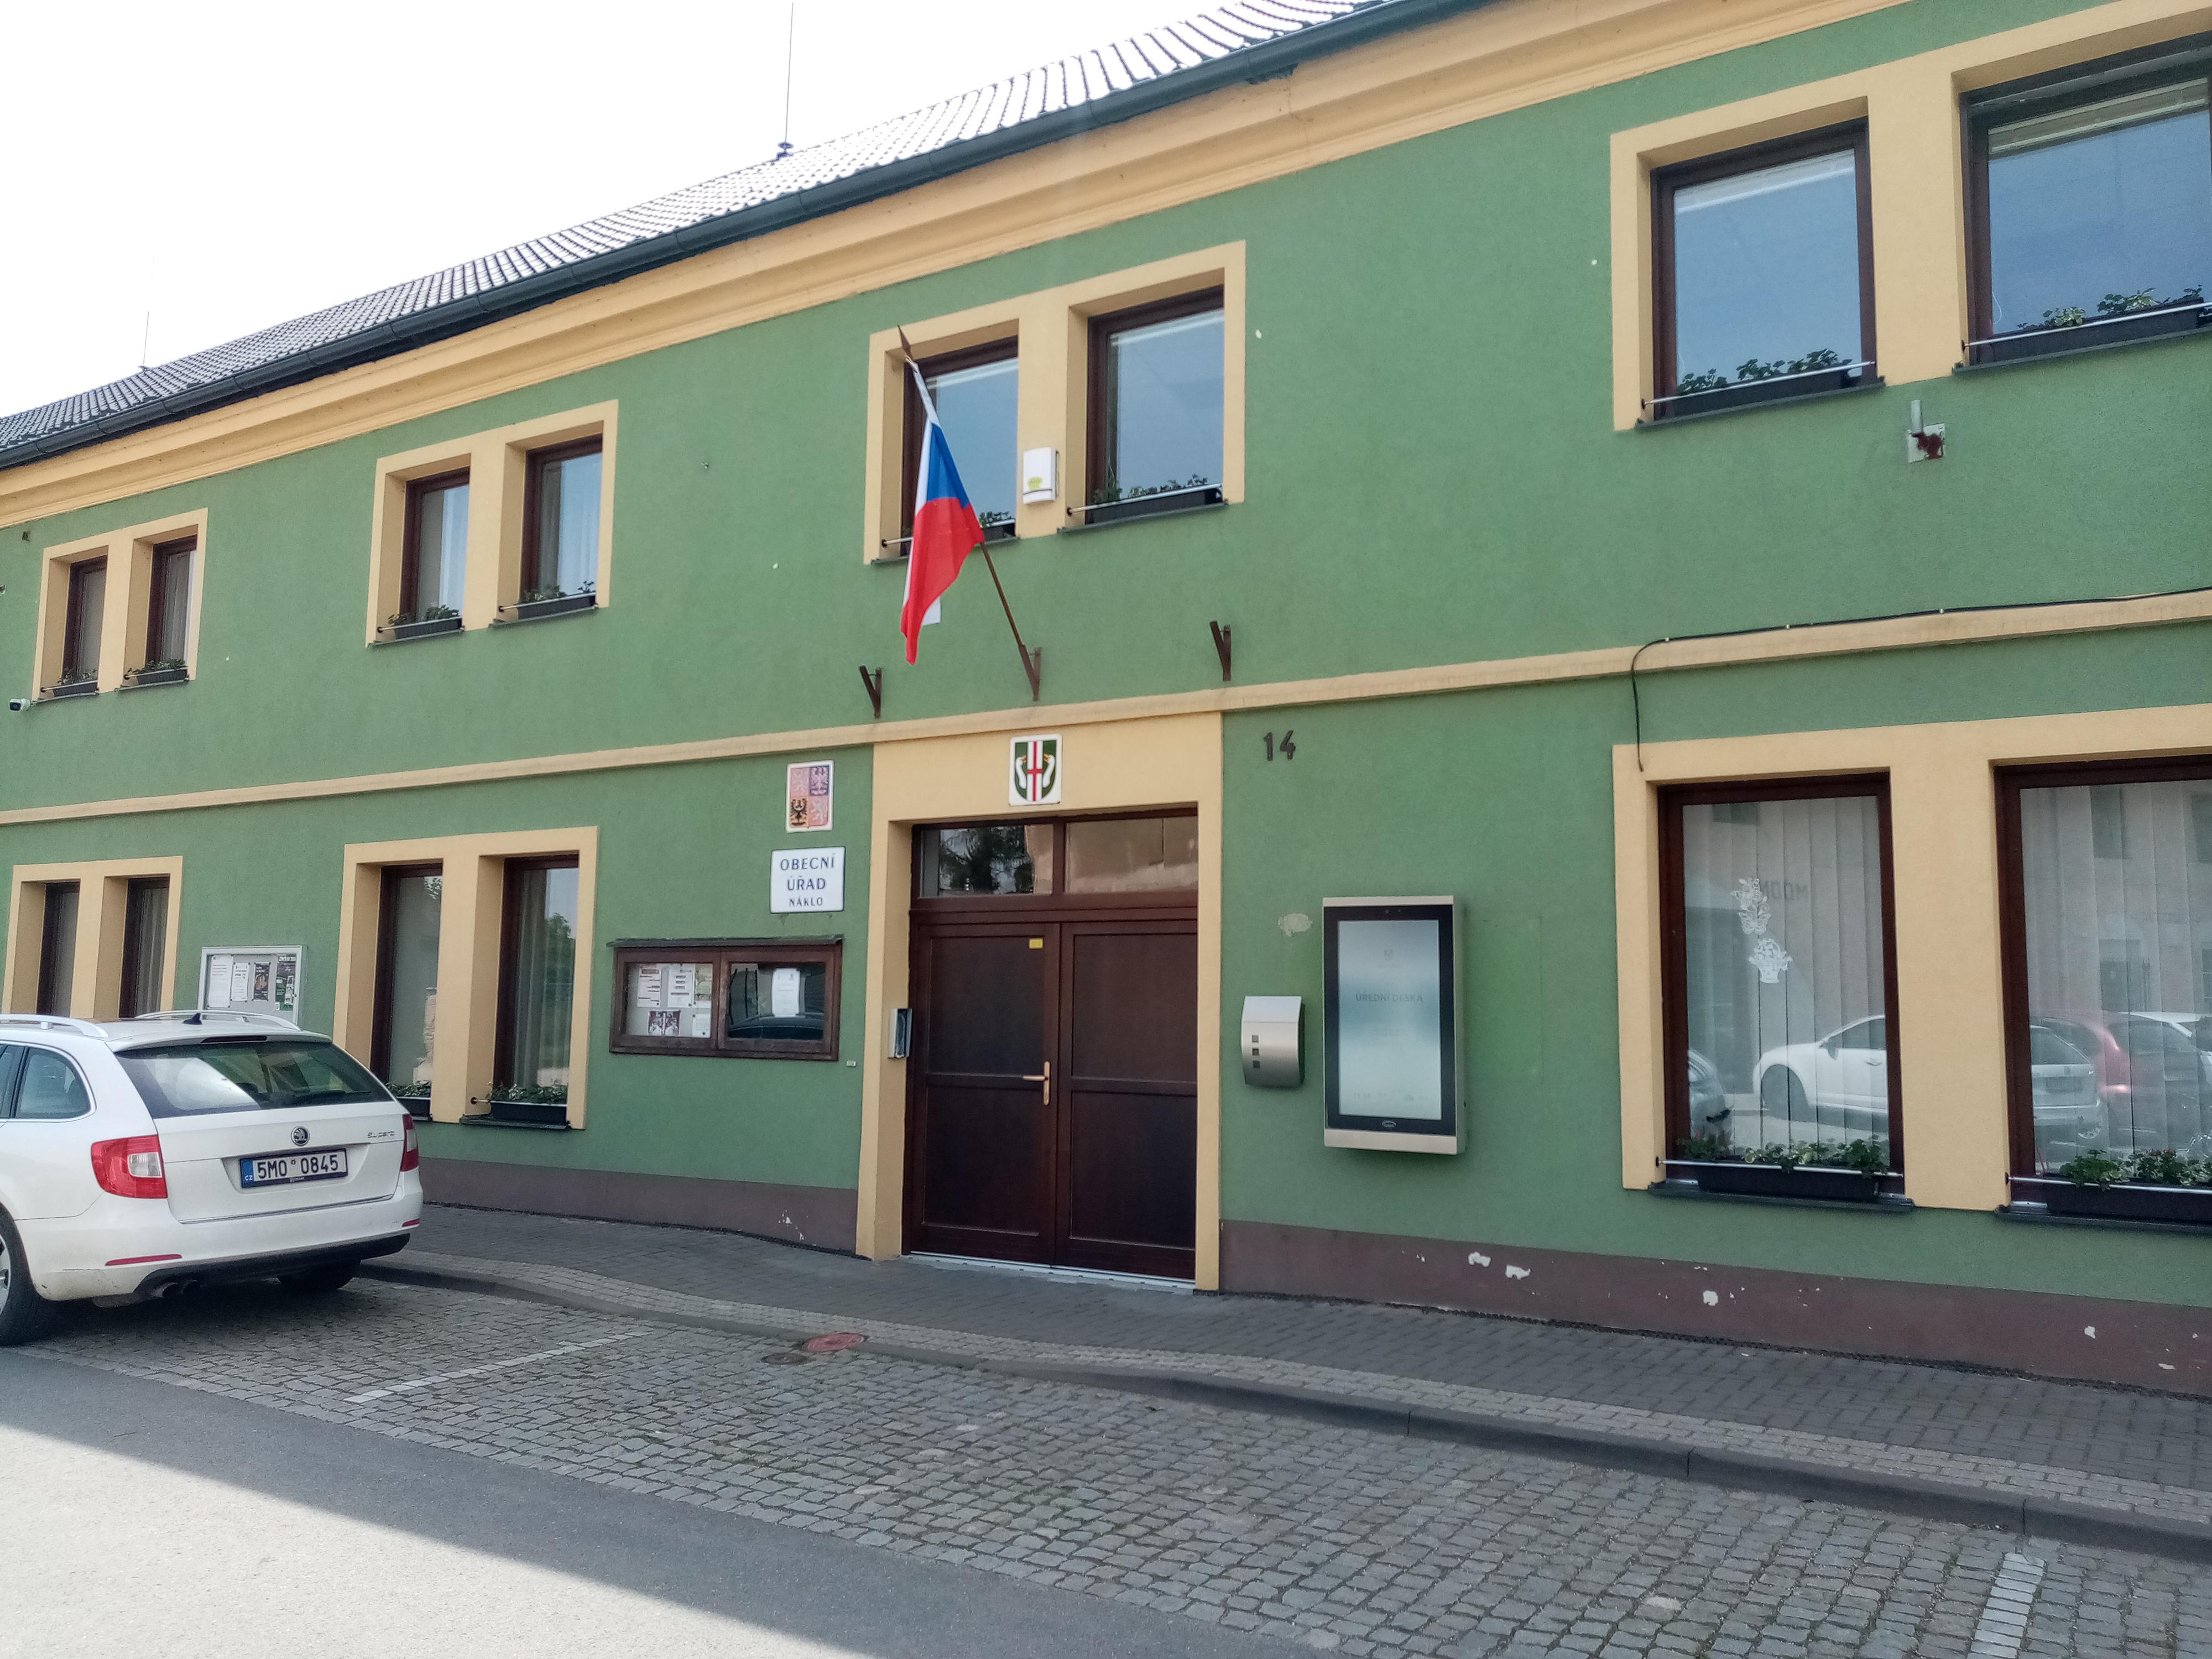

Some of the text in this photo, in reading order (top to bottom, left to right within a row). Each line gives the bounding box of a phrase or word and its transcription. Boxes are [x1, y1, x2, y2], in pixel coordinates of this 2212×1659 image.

[1263, 730, 1296, 761] 14
[780, 853, 835, 871] OBECNÍ
[787, 875, 826, 891] ÚŘAD
[789, 896, 823, 907] NÁKLO
[257, 1154, 338, 1180] 5M0 0845
